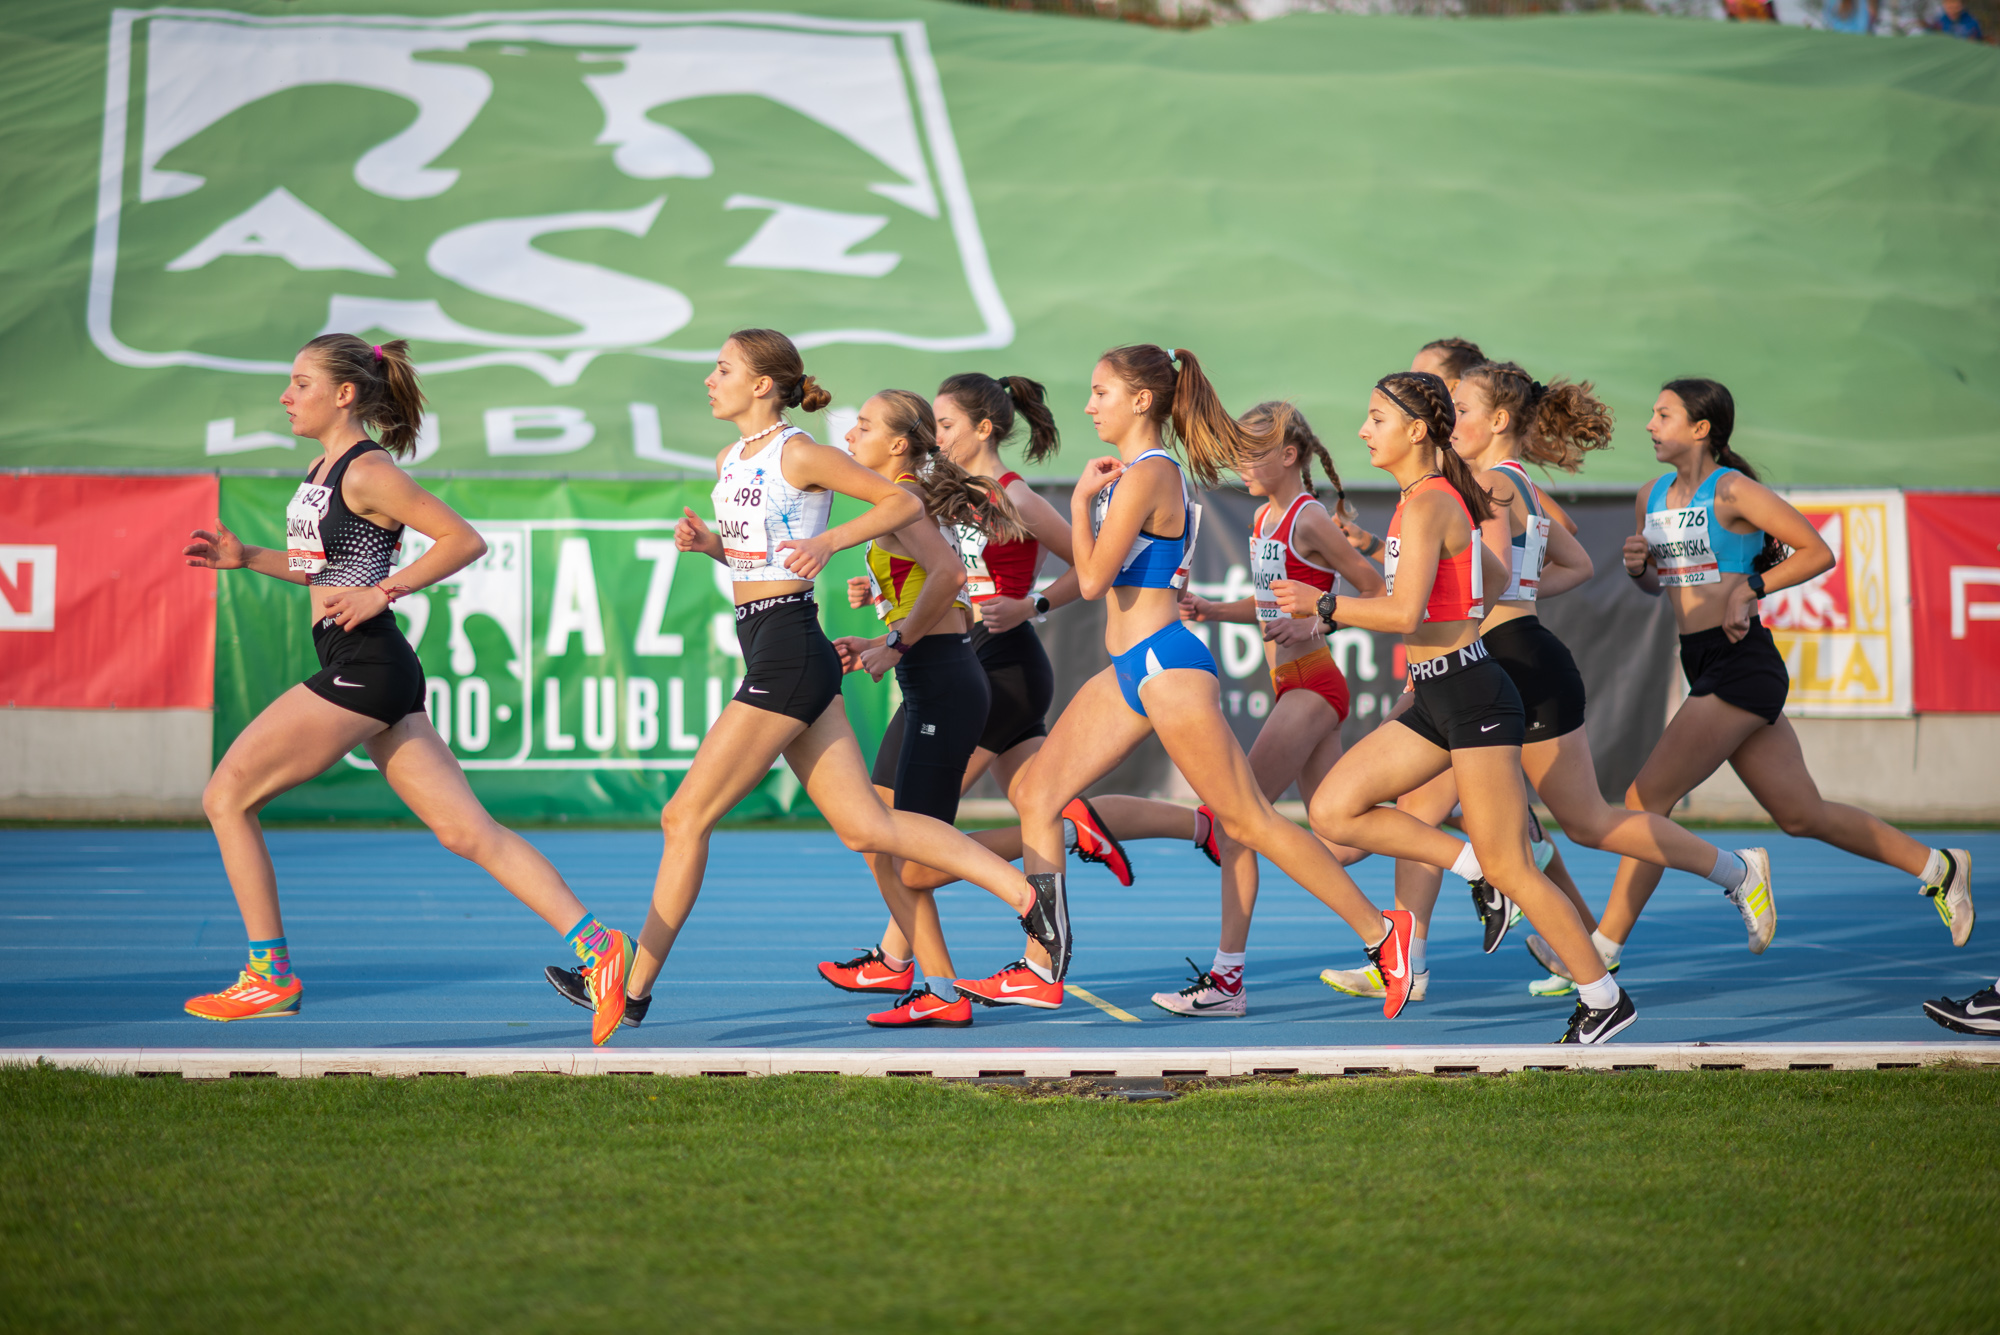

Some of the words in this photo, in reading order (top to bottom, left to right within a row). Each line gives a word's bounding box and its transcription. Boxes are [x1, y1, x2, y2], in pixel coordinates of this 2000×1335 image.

[302, 488, 326, 508] 642
[734, 487, 762, 507] 498
[1678, 510, 1706, 529] 726
[718, 519, 750, 543] ZAJĄC
[737, 559, 755, 569] 2022
[1684, 572, 1706, 583] 2022
[1260, 608, 1278, 618] 2022
[1411, 655, 1449, 681] PRO
[544, 677, 740, 751] LUBLI
